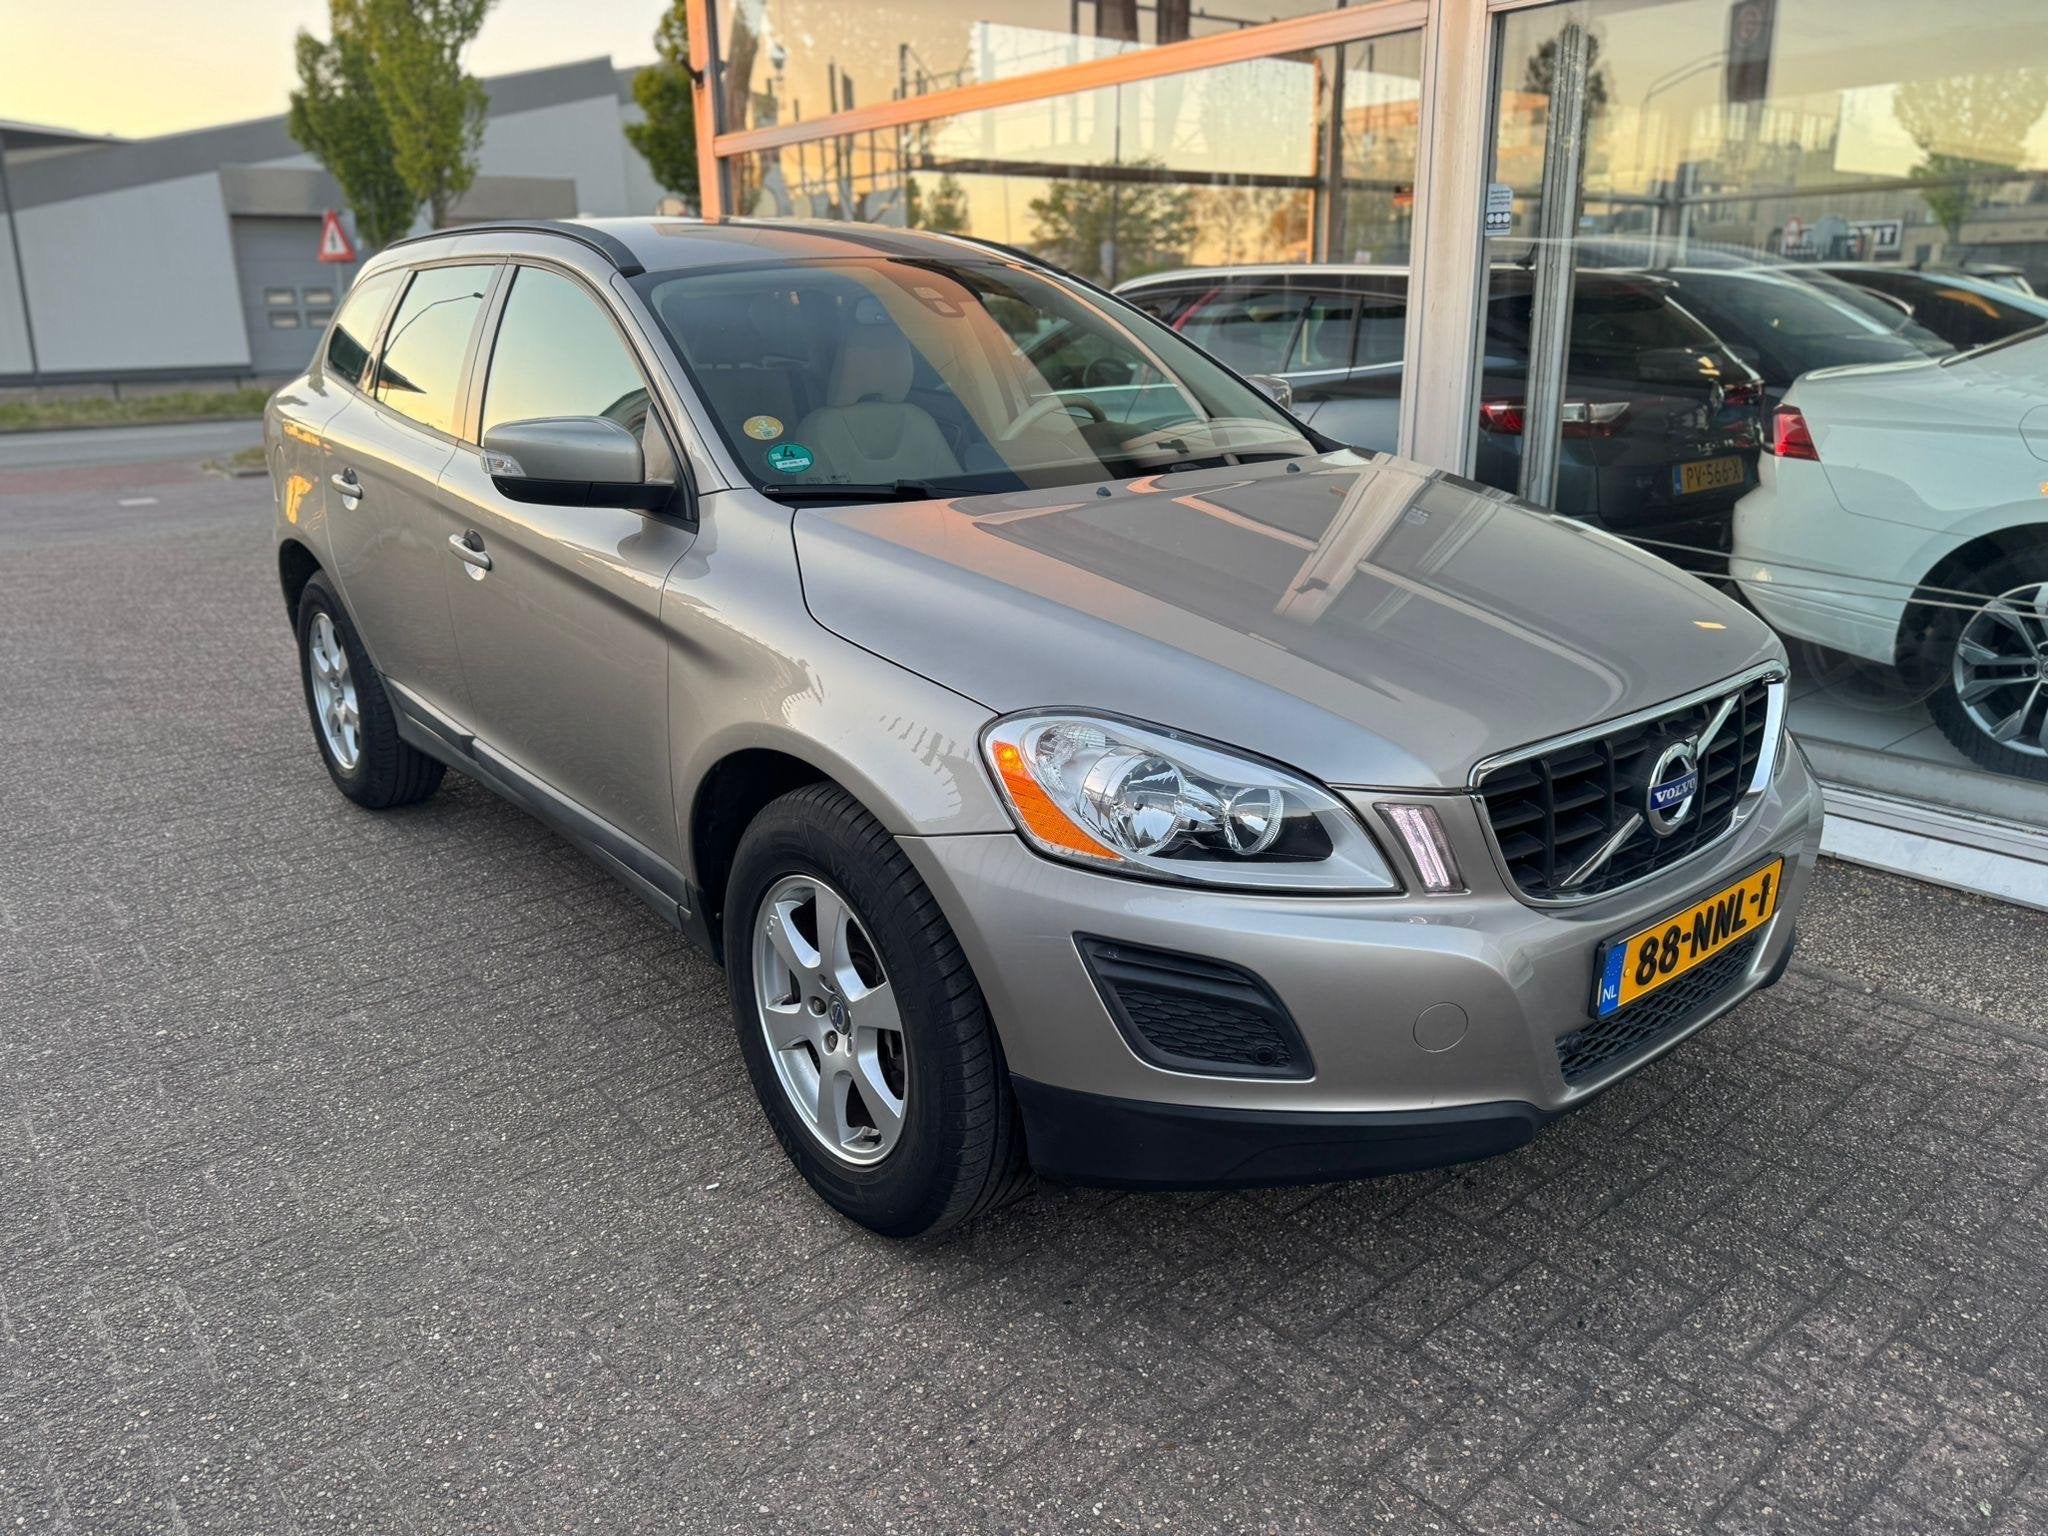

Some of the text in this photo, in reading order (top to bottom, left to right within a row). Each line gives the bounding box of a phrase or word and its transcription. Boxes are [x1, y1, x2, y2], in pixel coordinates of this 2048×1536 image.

[783, 446, 796, 458] 4
[1654, 778, 1696, 803] VOLVO
[1635, 873, 1772, 986] 88-NNL-1
[1602, 984, 1617, 1003] NL
